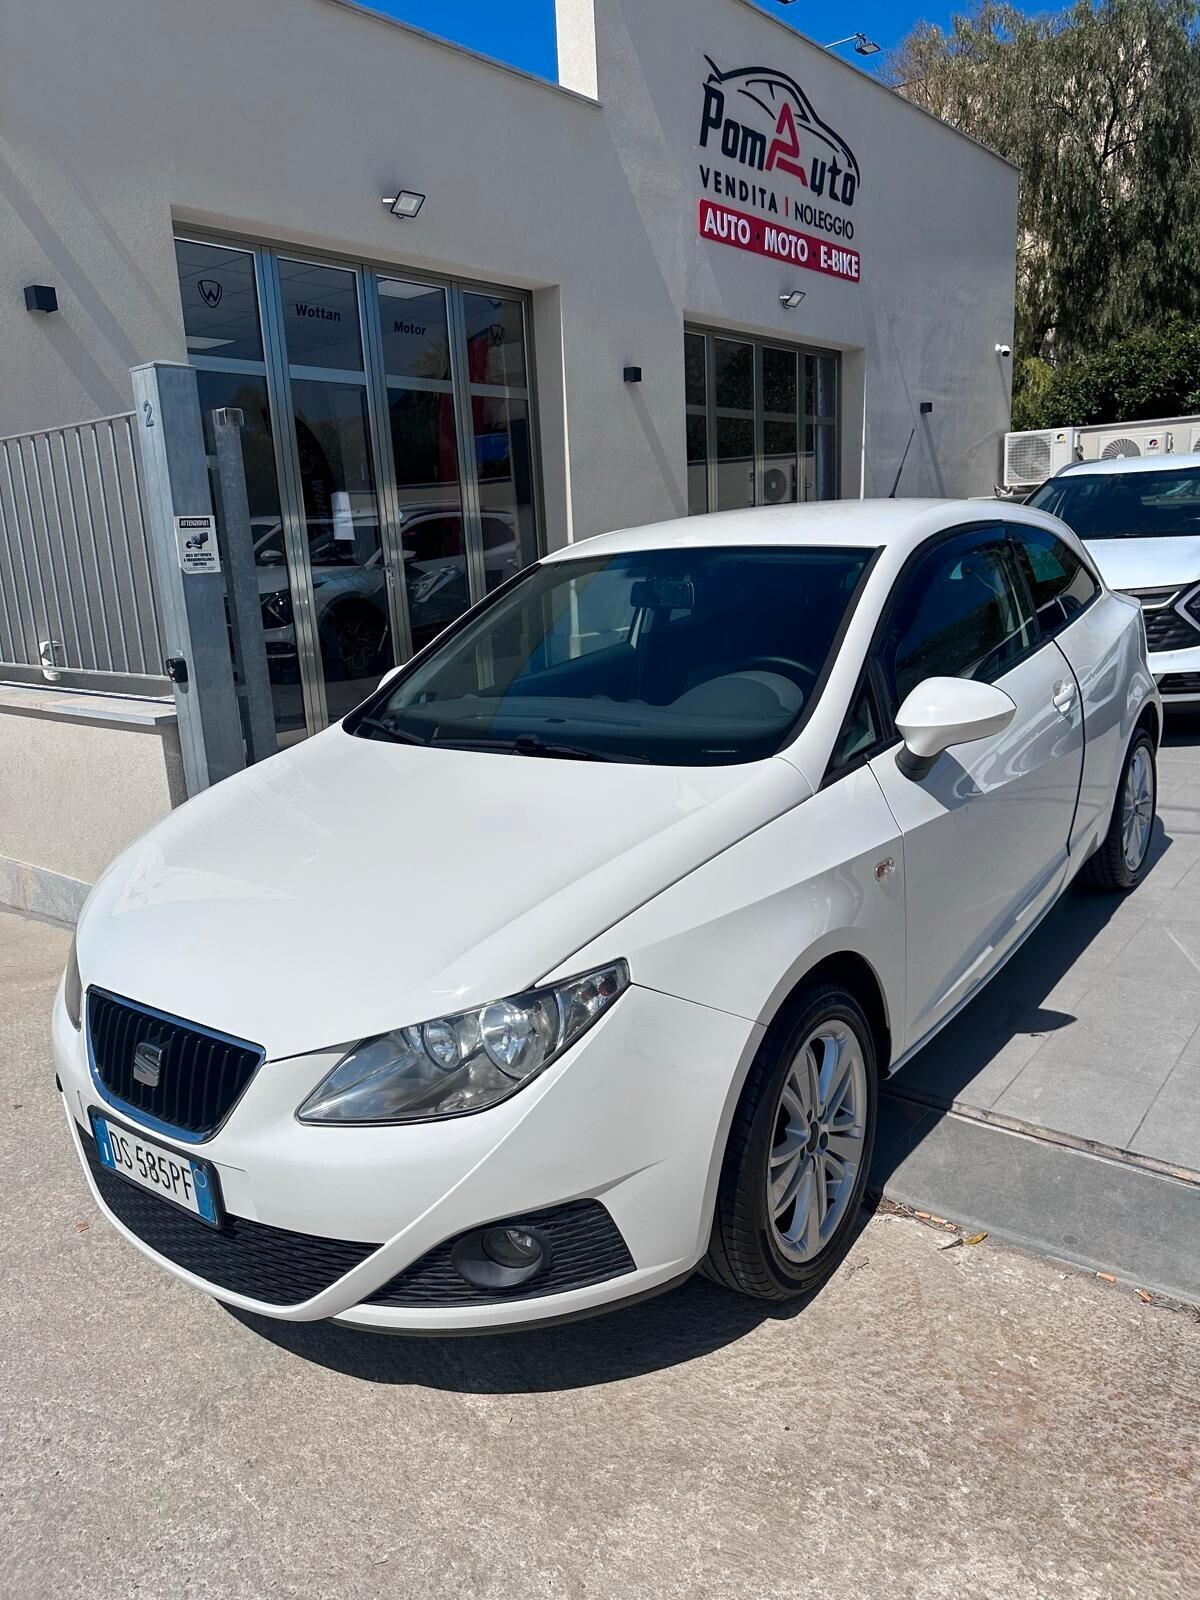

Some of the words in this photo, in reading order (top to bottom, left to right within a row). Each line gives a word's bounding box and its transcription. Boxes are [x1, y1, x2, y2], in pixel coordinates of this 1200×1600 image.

[699, 165, 778, 213] VENDITA
[795, 201, 854, 240] NOLEGGIO
[704, 207, 750, 245] AUTO
[764, 227, 809, 262] MOTO
[820, 245, 859, 278] E-BIKE
[295, 303, 341, 322] Wottan
[394, 320, 426, 337] Motor
[143, 400, 154, 427] 2
[109, 1131, 133, 1170] DS
[135, 1145, 192, 1201] 585PF
